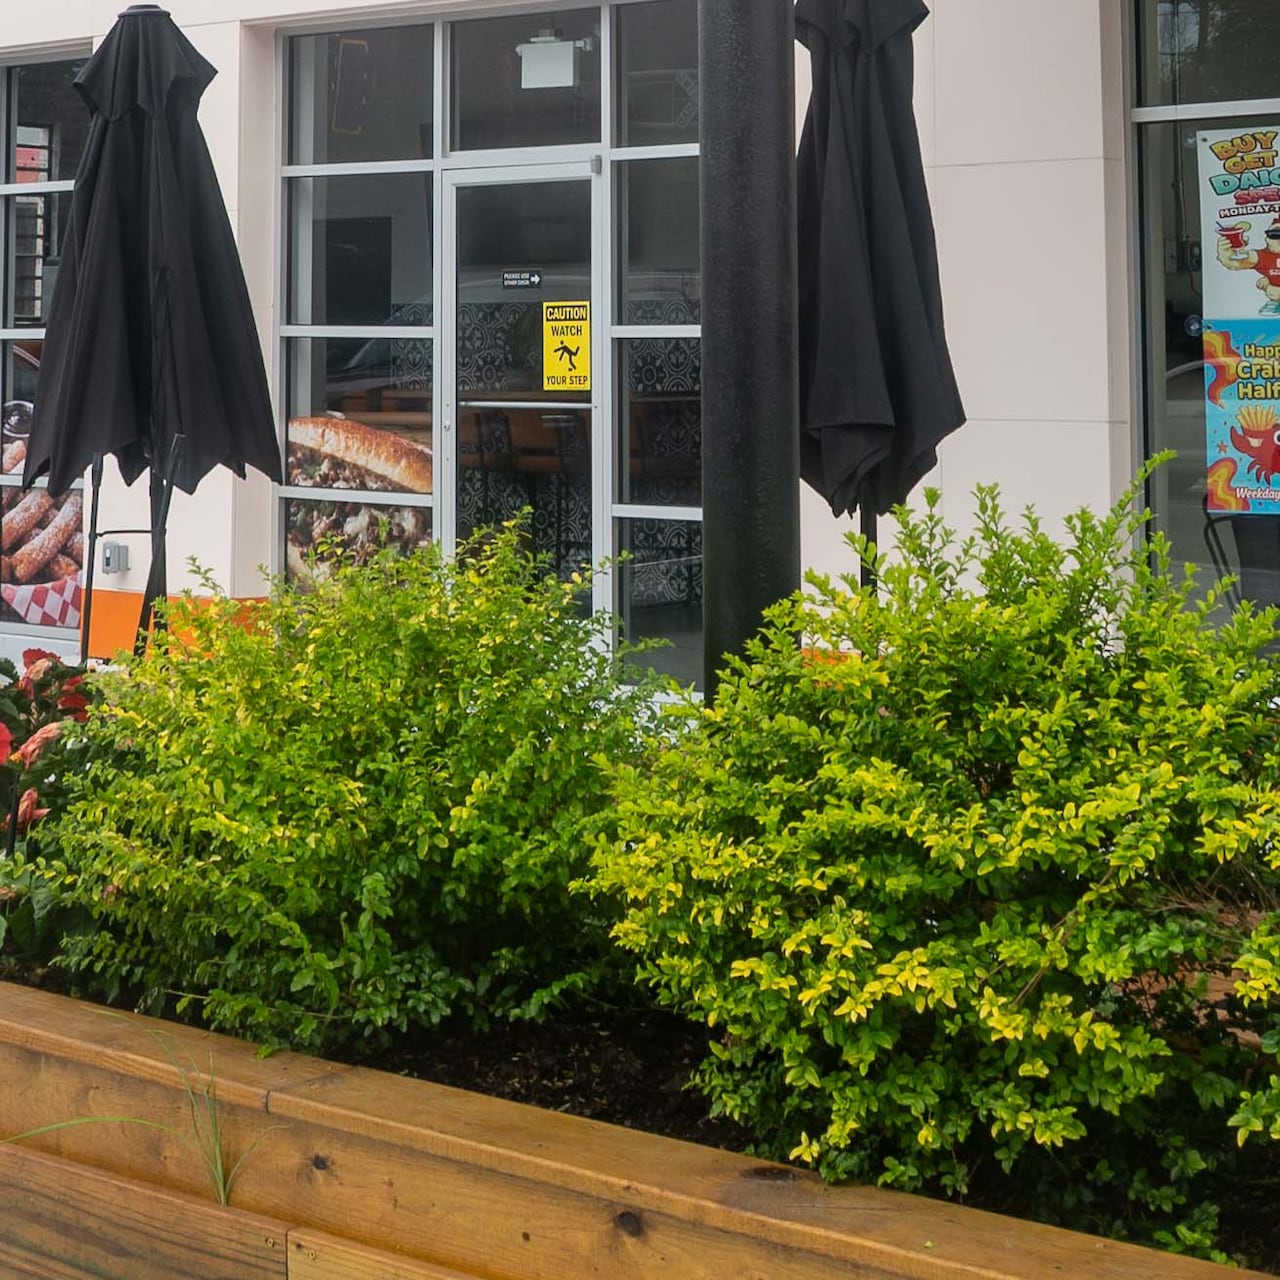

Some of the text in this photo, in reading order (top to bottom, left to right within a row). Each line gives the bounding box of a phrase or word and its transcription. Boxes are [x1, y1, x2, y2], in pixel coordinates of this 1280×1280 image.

[1211, 131, 1278, 161] BUY
[1224, 150, 1278, 174] GET
[546, 307, 586, 319] CAUTION
[551, 325, 582, 336] WATCH
[546, 376, 588, 385] YOUR STEP
